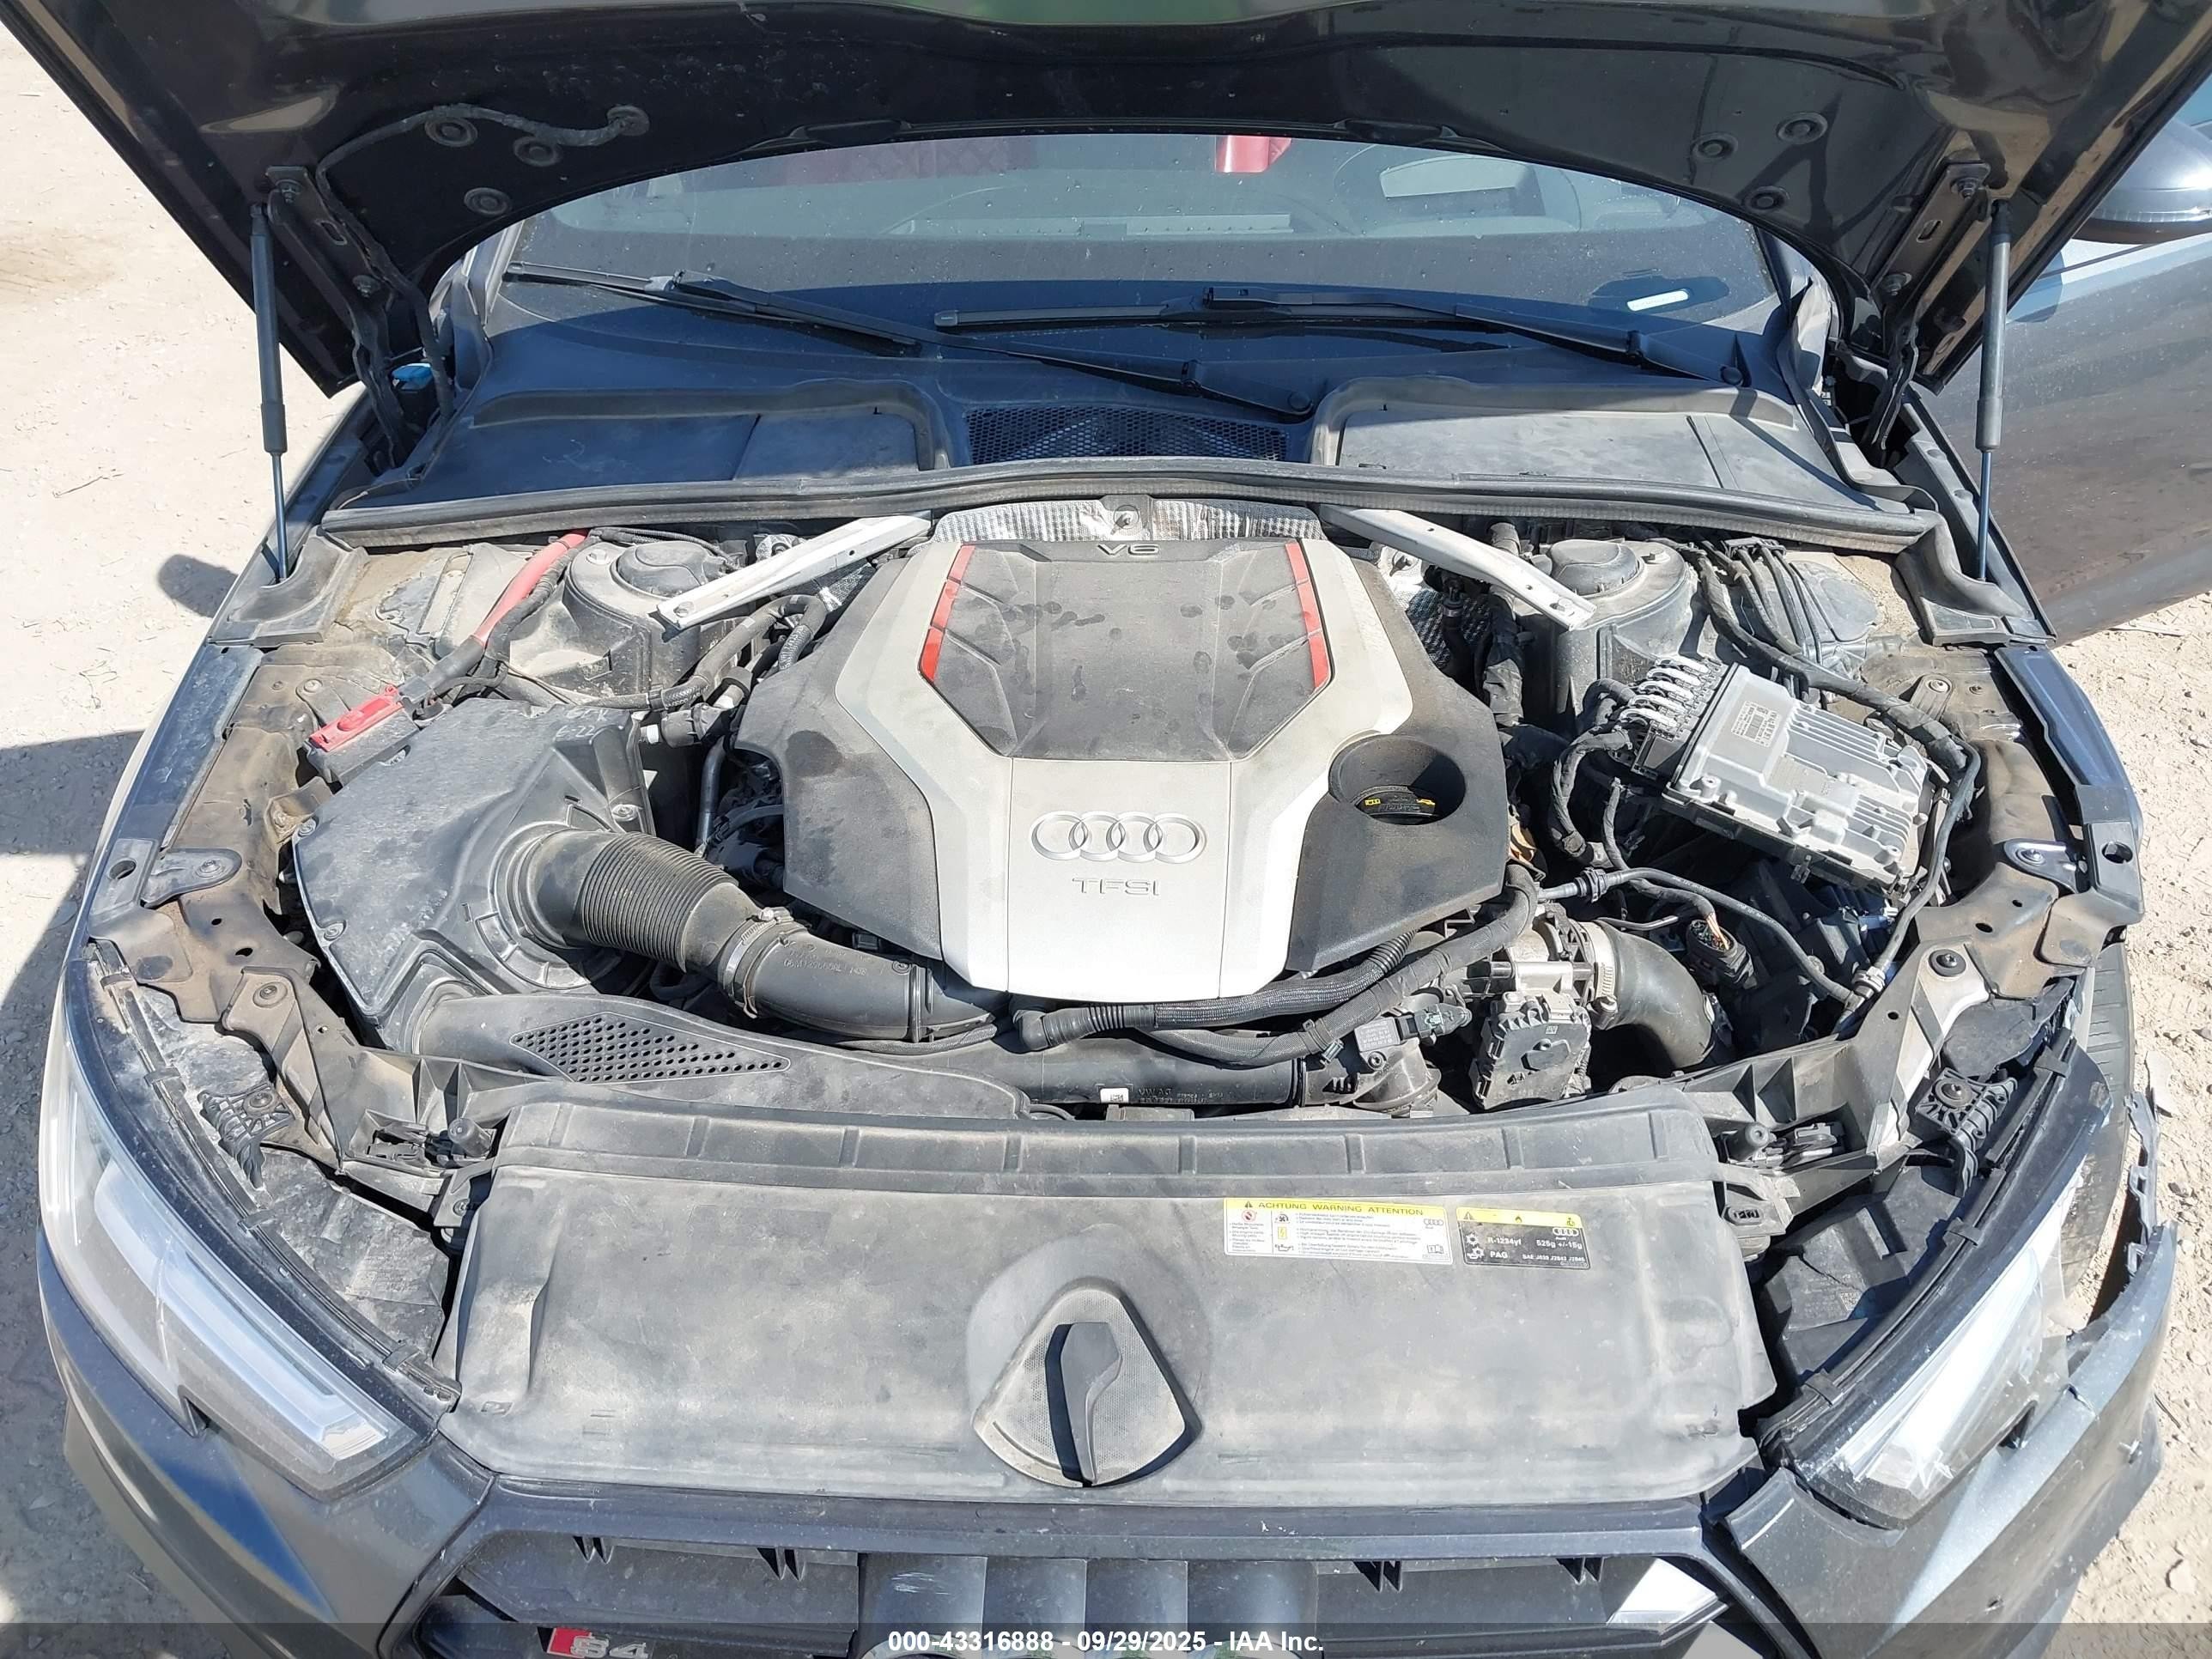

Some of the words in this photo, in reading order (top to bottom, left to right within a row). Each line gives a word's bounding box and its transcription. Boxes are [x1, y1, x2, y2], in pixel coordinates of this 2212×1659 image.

[1097, 544, 1160, 556] V6
[1072, 878, 1159, 896] TFSI
[1258, 1201, 1307, 1210] ACHTUNG
[1312, 1204, 1363, 1212] WARNING
[1368, 1206, 1424, 1216] ATTENTION
[1490, 1250, 1509, 1259] PAG
[569, 1634, 649, 1659] S4
